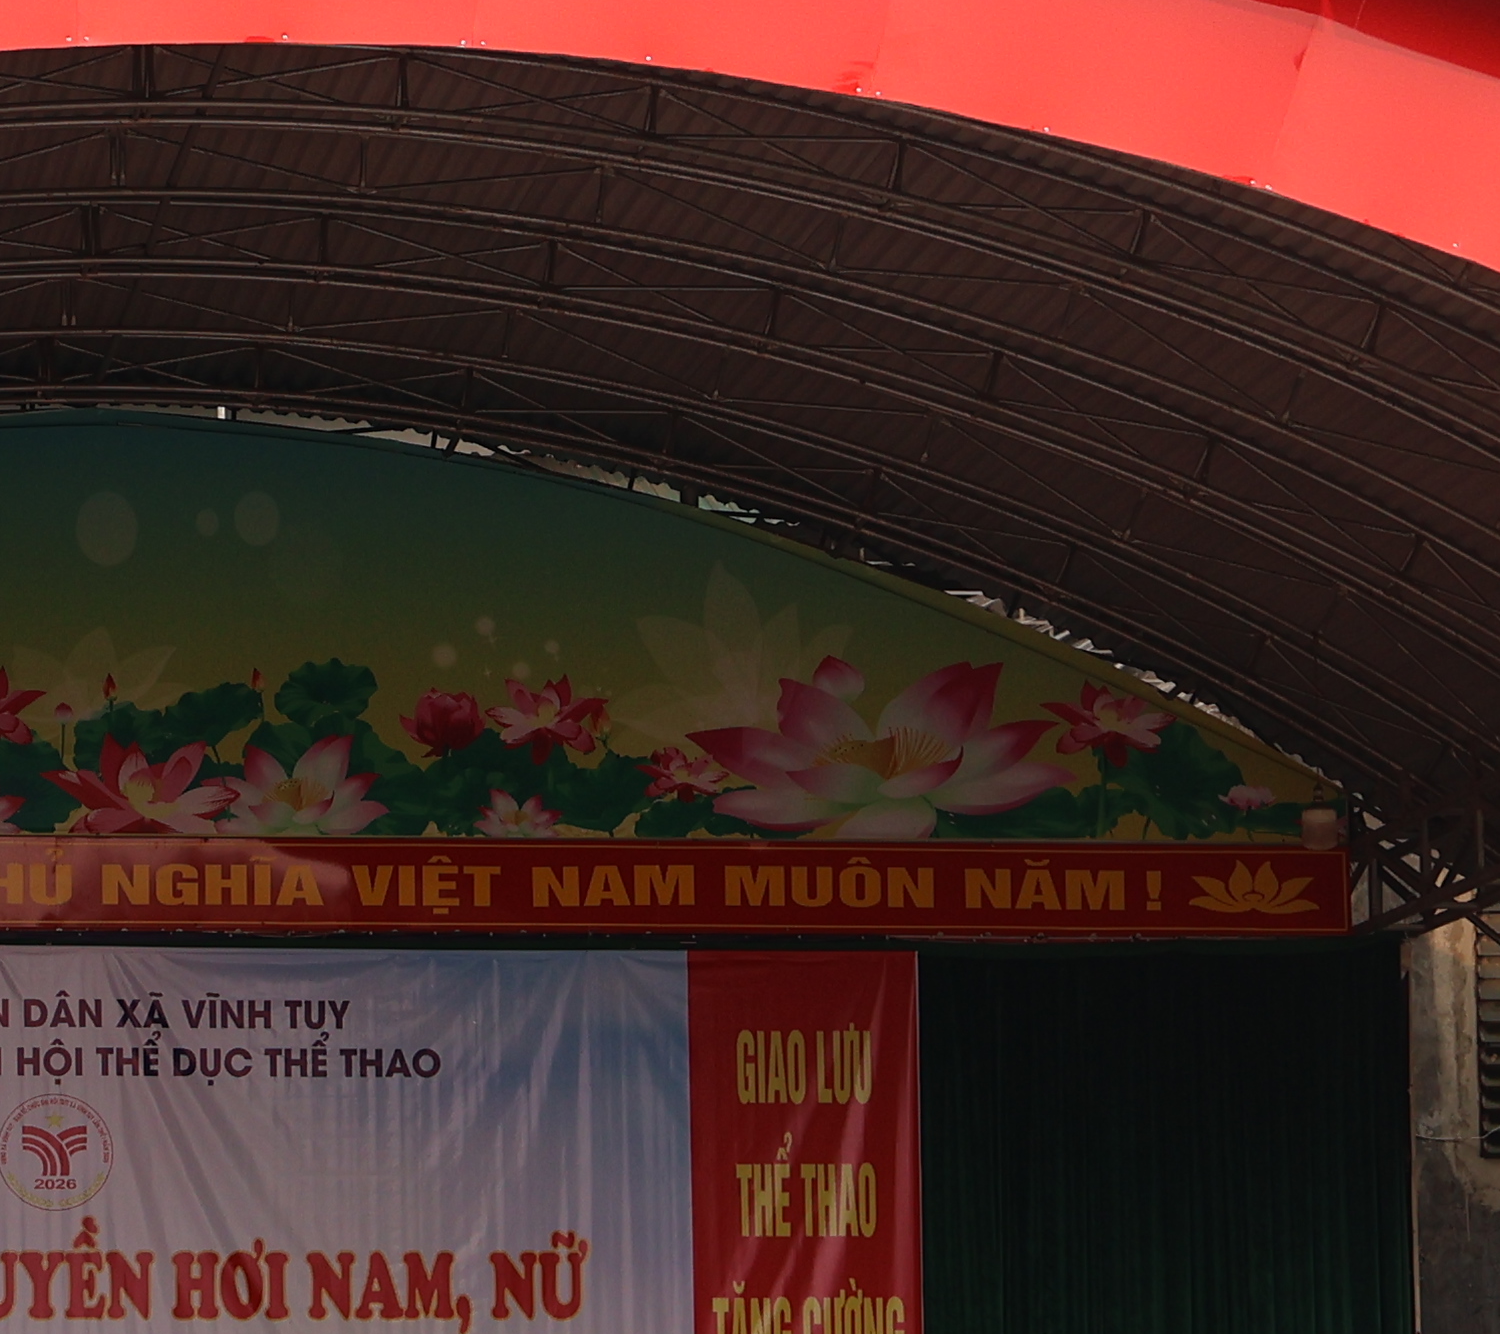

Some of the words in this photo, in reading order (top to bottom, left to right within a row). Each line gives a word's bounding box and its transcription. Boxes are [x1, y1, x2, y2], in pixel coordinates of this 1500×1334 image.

[101, 855, 323, 906] NGHĨA
[352, 855, 500, 915] VIỆT
[533, 865, 696, 907] NAM
[725, 856, 933, 909] MUÔN
[966, 858, 1136, 911] NĂM
[1144, 871, 1163, 911] !
[24, 990, 102, 1028] DÂN
[116, 992, 168, 1028] XÃ
[182, 993, 272, 1029] VĨNH
[285, 1000, 350, 1029] TUY
[17, 1038, 83, 1085] HỘI
[96, 1031, 159, 1077] THỂ
[173, 1047, 253, 1086] DỤC
[264, 1031, 328, 1077] THỂ
[340, 1048, 441, 1078] THAO
[736, 1030, 806, 1104] GIAO
[816, 1022, 872, 1104] LƯU
[34, 1178, 77, 1190] 2026
[736, 1131, 791, 1237] THỂ
[801, 1162, 877, 1237] THAO
[171, 1238, 290, 1322] HƠI
[489, 1230, 590, 1322] NỮ
